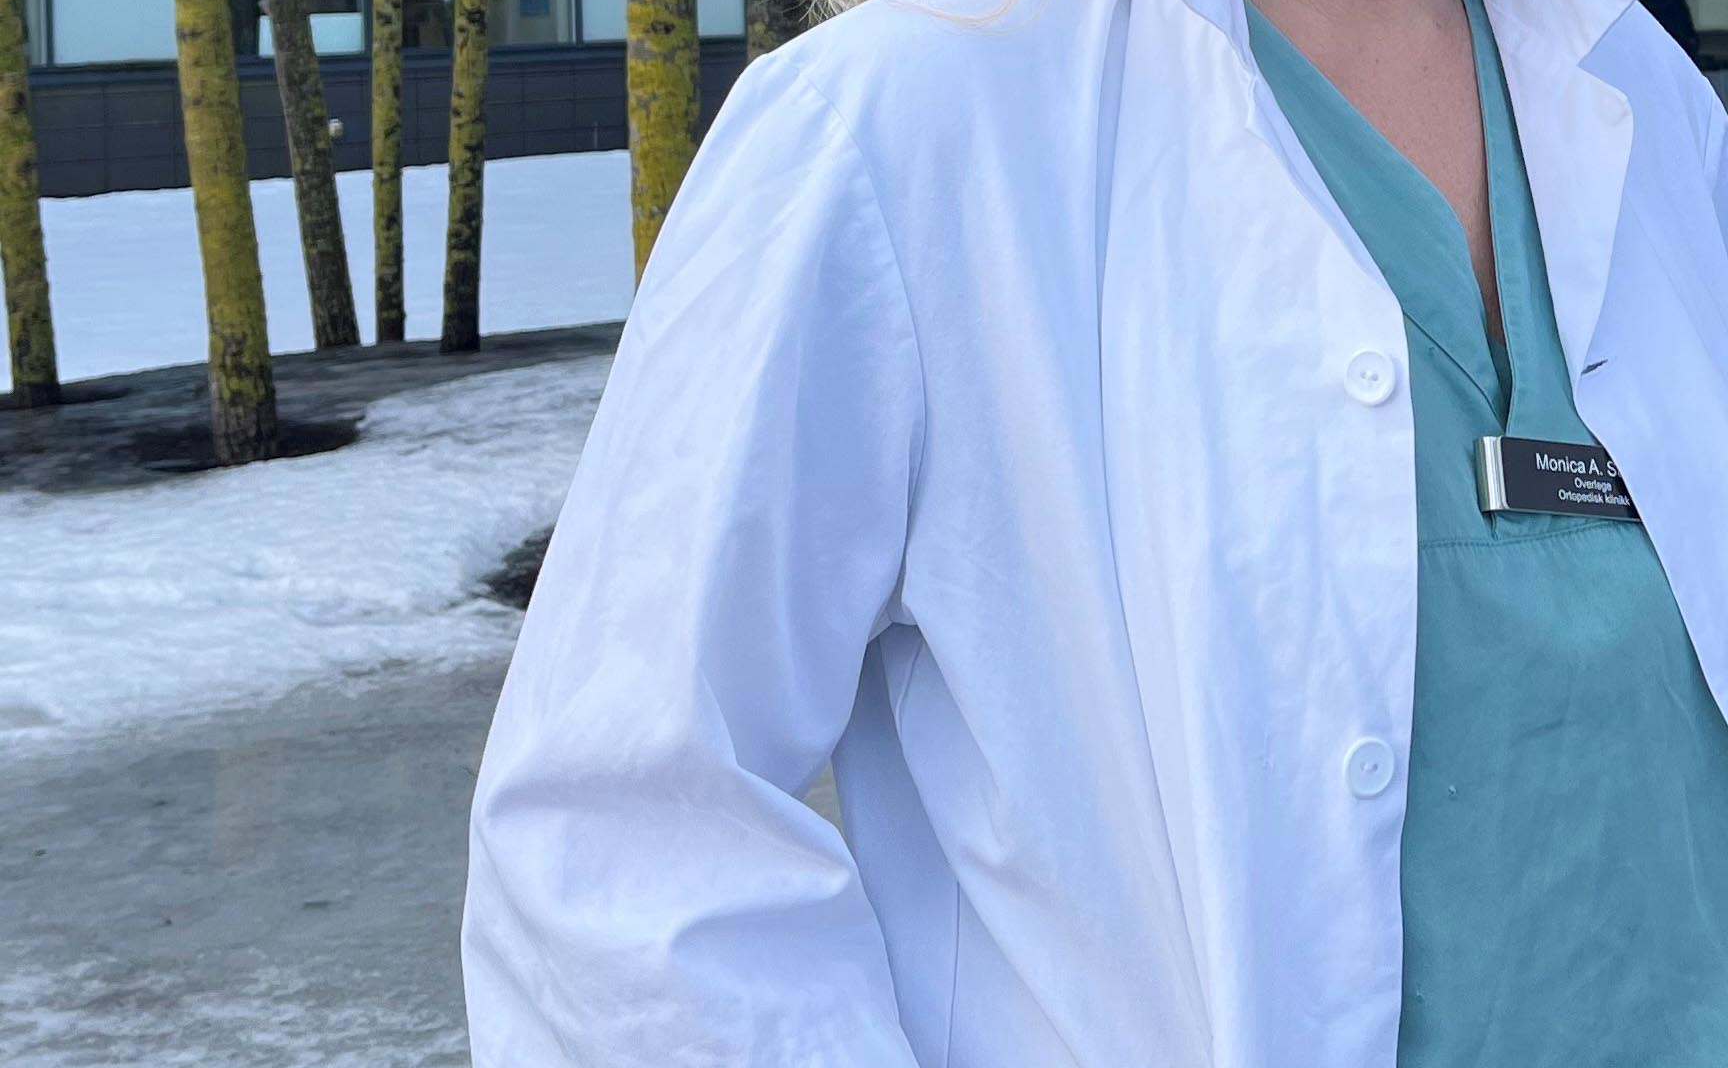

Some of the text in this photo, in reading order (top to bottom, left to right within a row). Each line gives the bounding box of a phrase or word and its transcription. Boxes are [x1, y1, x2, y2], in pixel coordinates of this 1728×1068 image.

[1535, 452, 1586, 474] Monica
[1588, 458, 1604, 476] A.
[1574, 477, 1612, 493] Overlege
[1558, 489, 1631, 507] Ortopedisk klinikk
